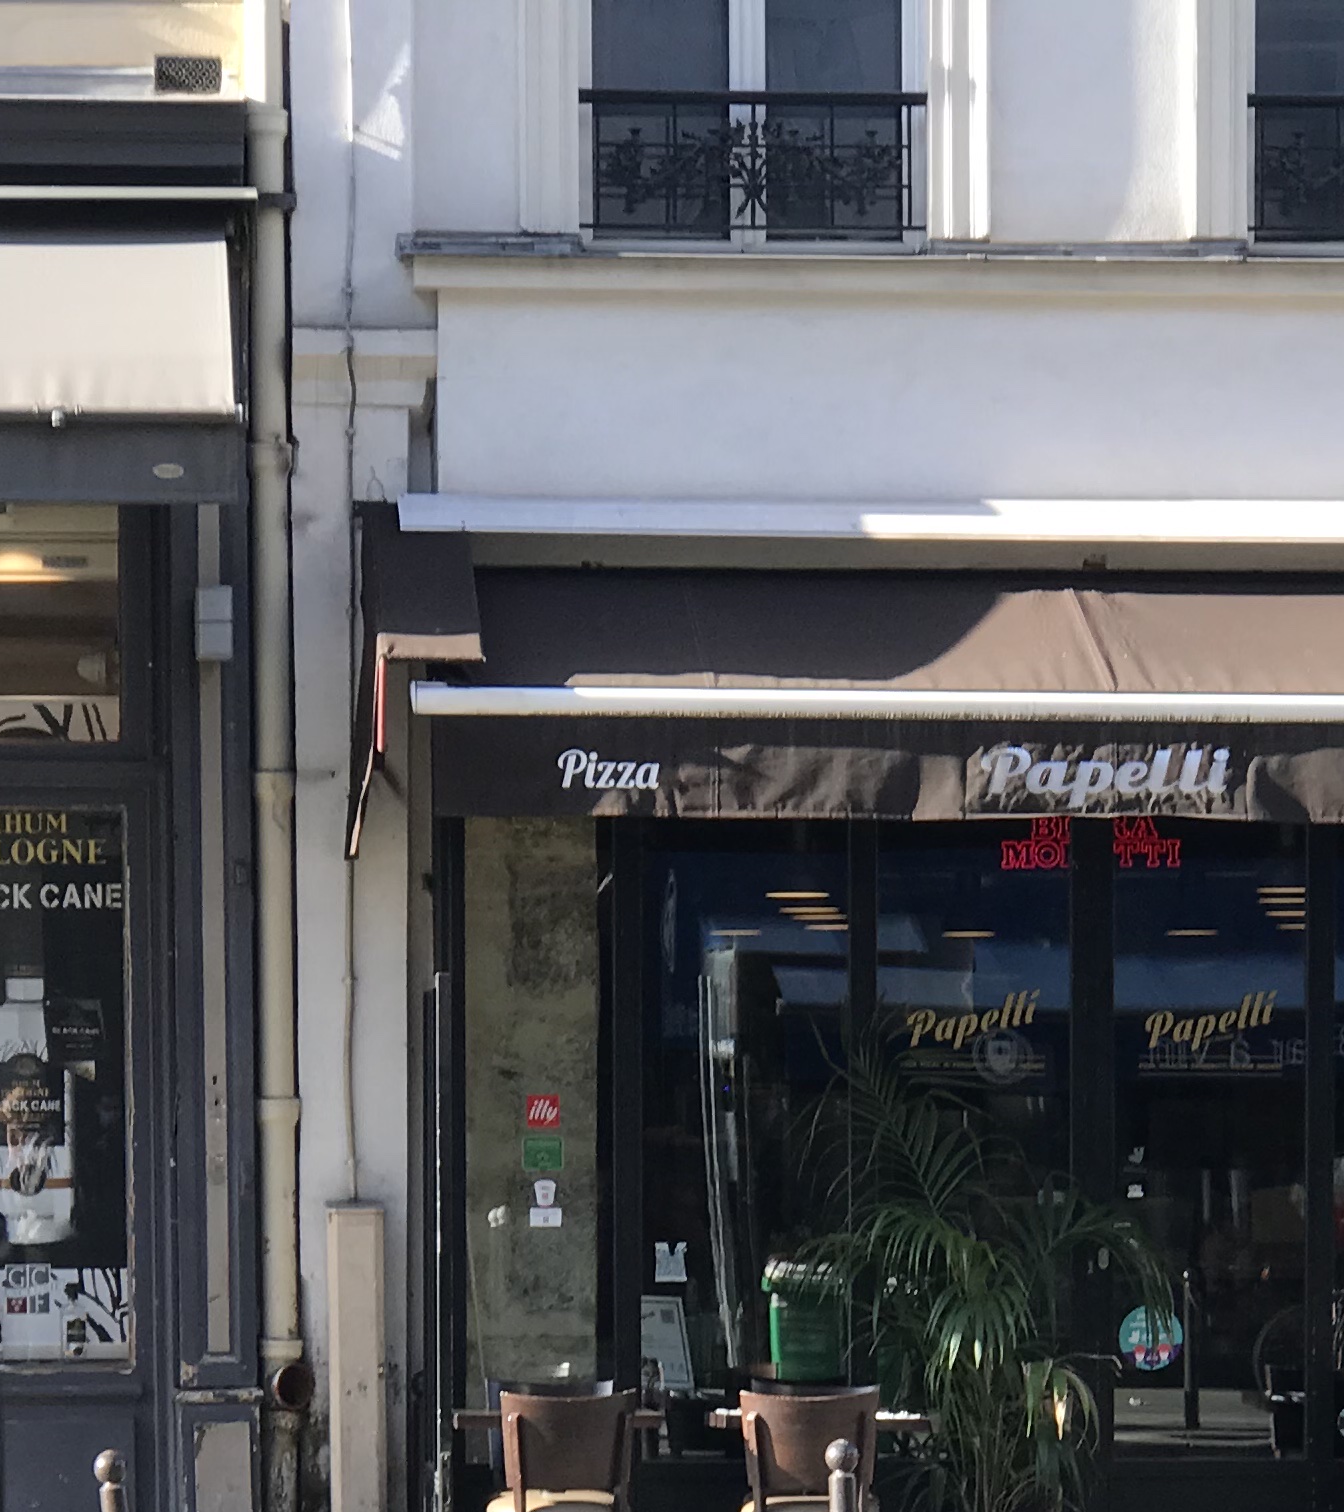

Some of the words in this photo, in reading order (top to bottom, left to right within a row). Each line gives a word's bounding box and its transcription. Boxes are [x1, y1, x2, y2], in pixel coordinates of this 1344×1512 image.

[556, 748, 661, 790] Pizza
[980, 745, 1231, 808] Papelli
[1001, 839, 1182, 870] MOTTI
[40, 882, 123, 910] CANE
[906, 988, 1042, 1051] Papelli
[1144, 989, 1279, 1052] Papelli
[528, 1098, 559, 1126] illy
